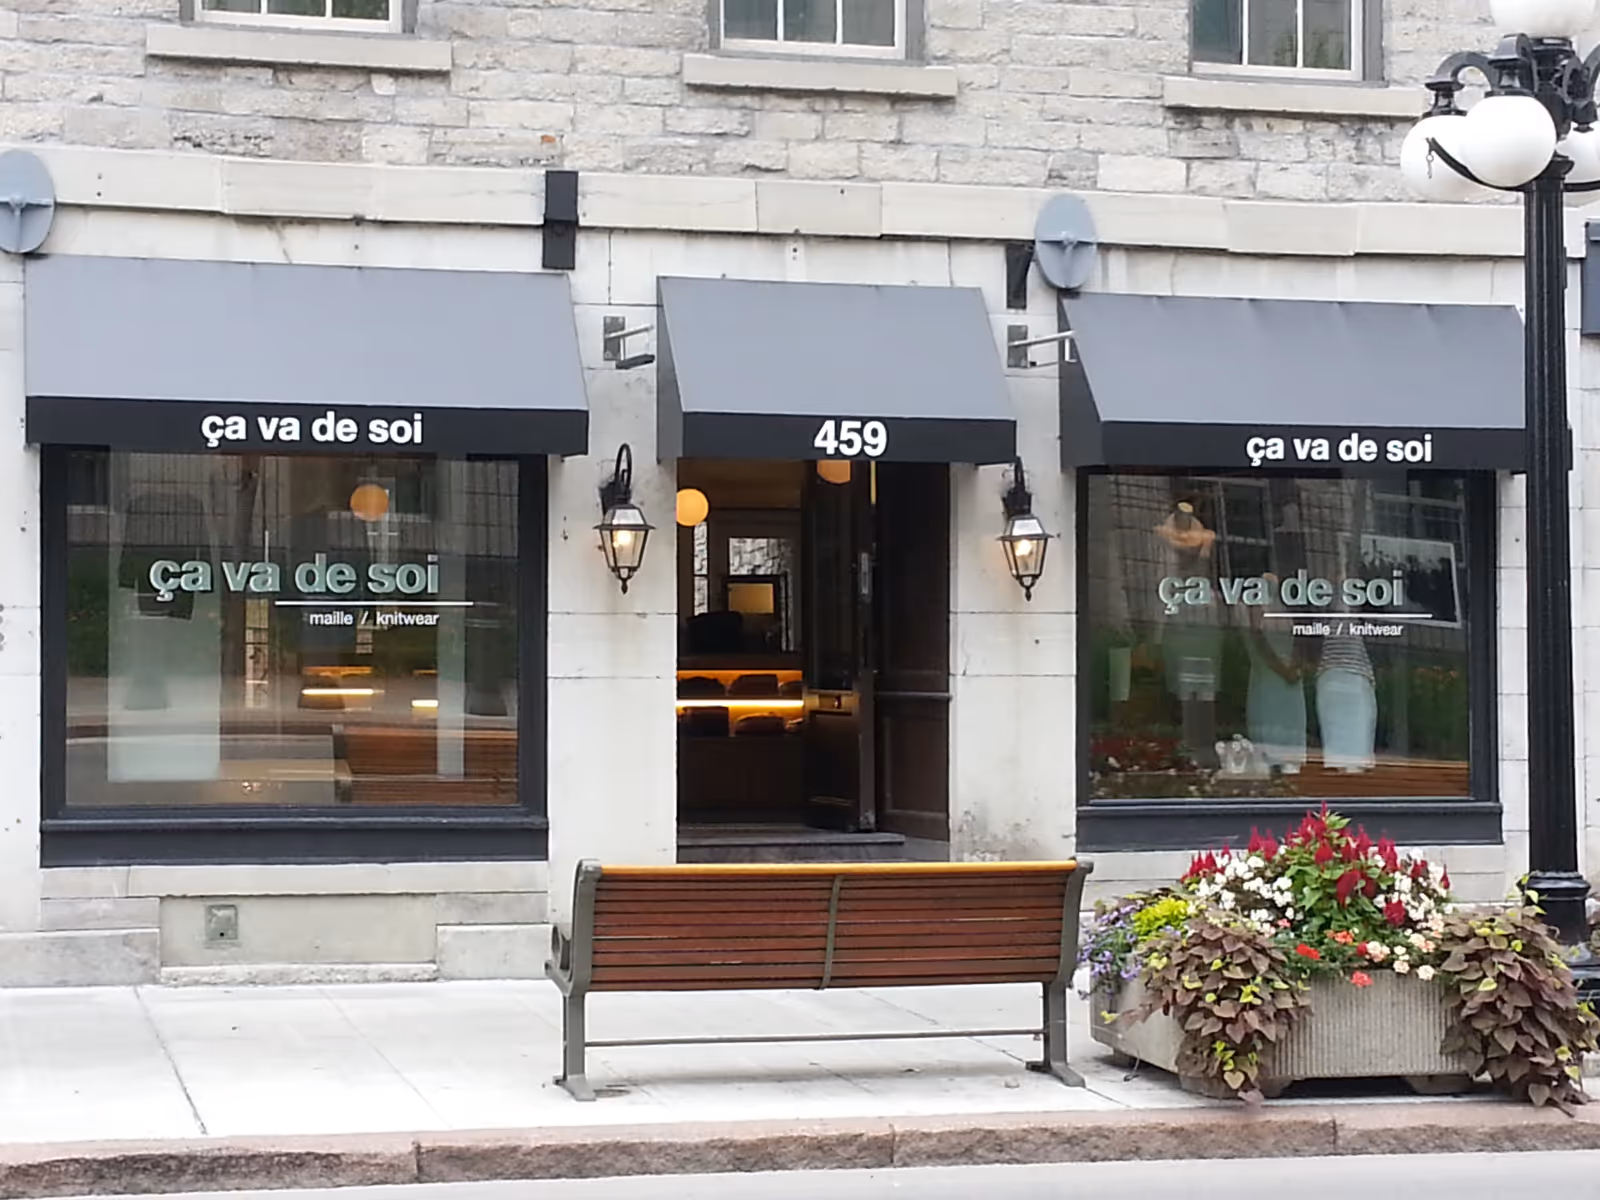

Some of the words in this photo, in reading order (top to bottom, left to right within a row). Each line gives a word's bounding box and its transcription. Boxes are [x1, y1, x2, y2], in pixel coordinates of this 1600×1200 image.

[201, 414, 247, 448] ça
[258, 417, 301, 442] va
[312, 411, 358, 442] de
[368, 413, 423, 444] soi
[814, 420, 888, 457] 459
[1246, 437, 1285, 467] ça
[1293, 437, 1330, 461] va
[1338, 432, 1378, 462] de
[1386, 434, 1432, 462] soi
[149, 560, 212, 602] ça
[222, 561, 281, 594] va
[294, 554, 357, 594] de
[367, 555, 440, 595] soi
[1157, 576, 1211, 614] ça
[1220, 576, 1274, 606] va
[1280, 570, 1333, 606] de
[1341, 570, 1404, 606] soi
[309, 611, 353, 626] maille
[376, 611, 440, 627] knitwear
[1292, 623, 1331, 637] maille
[1348, 623, 1404, 637] knitwear
